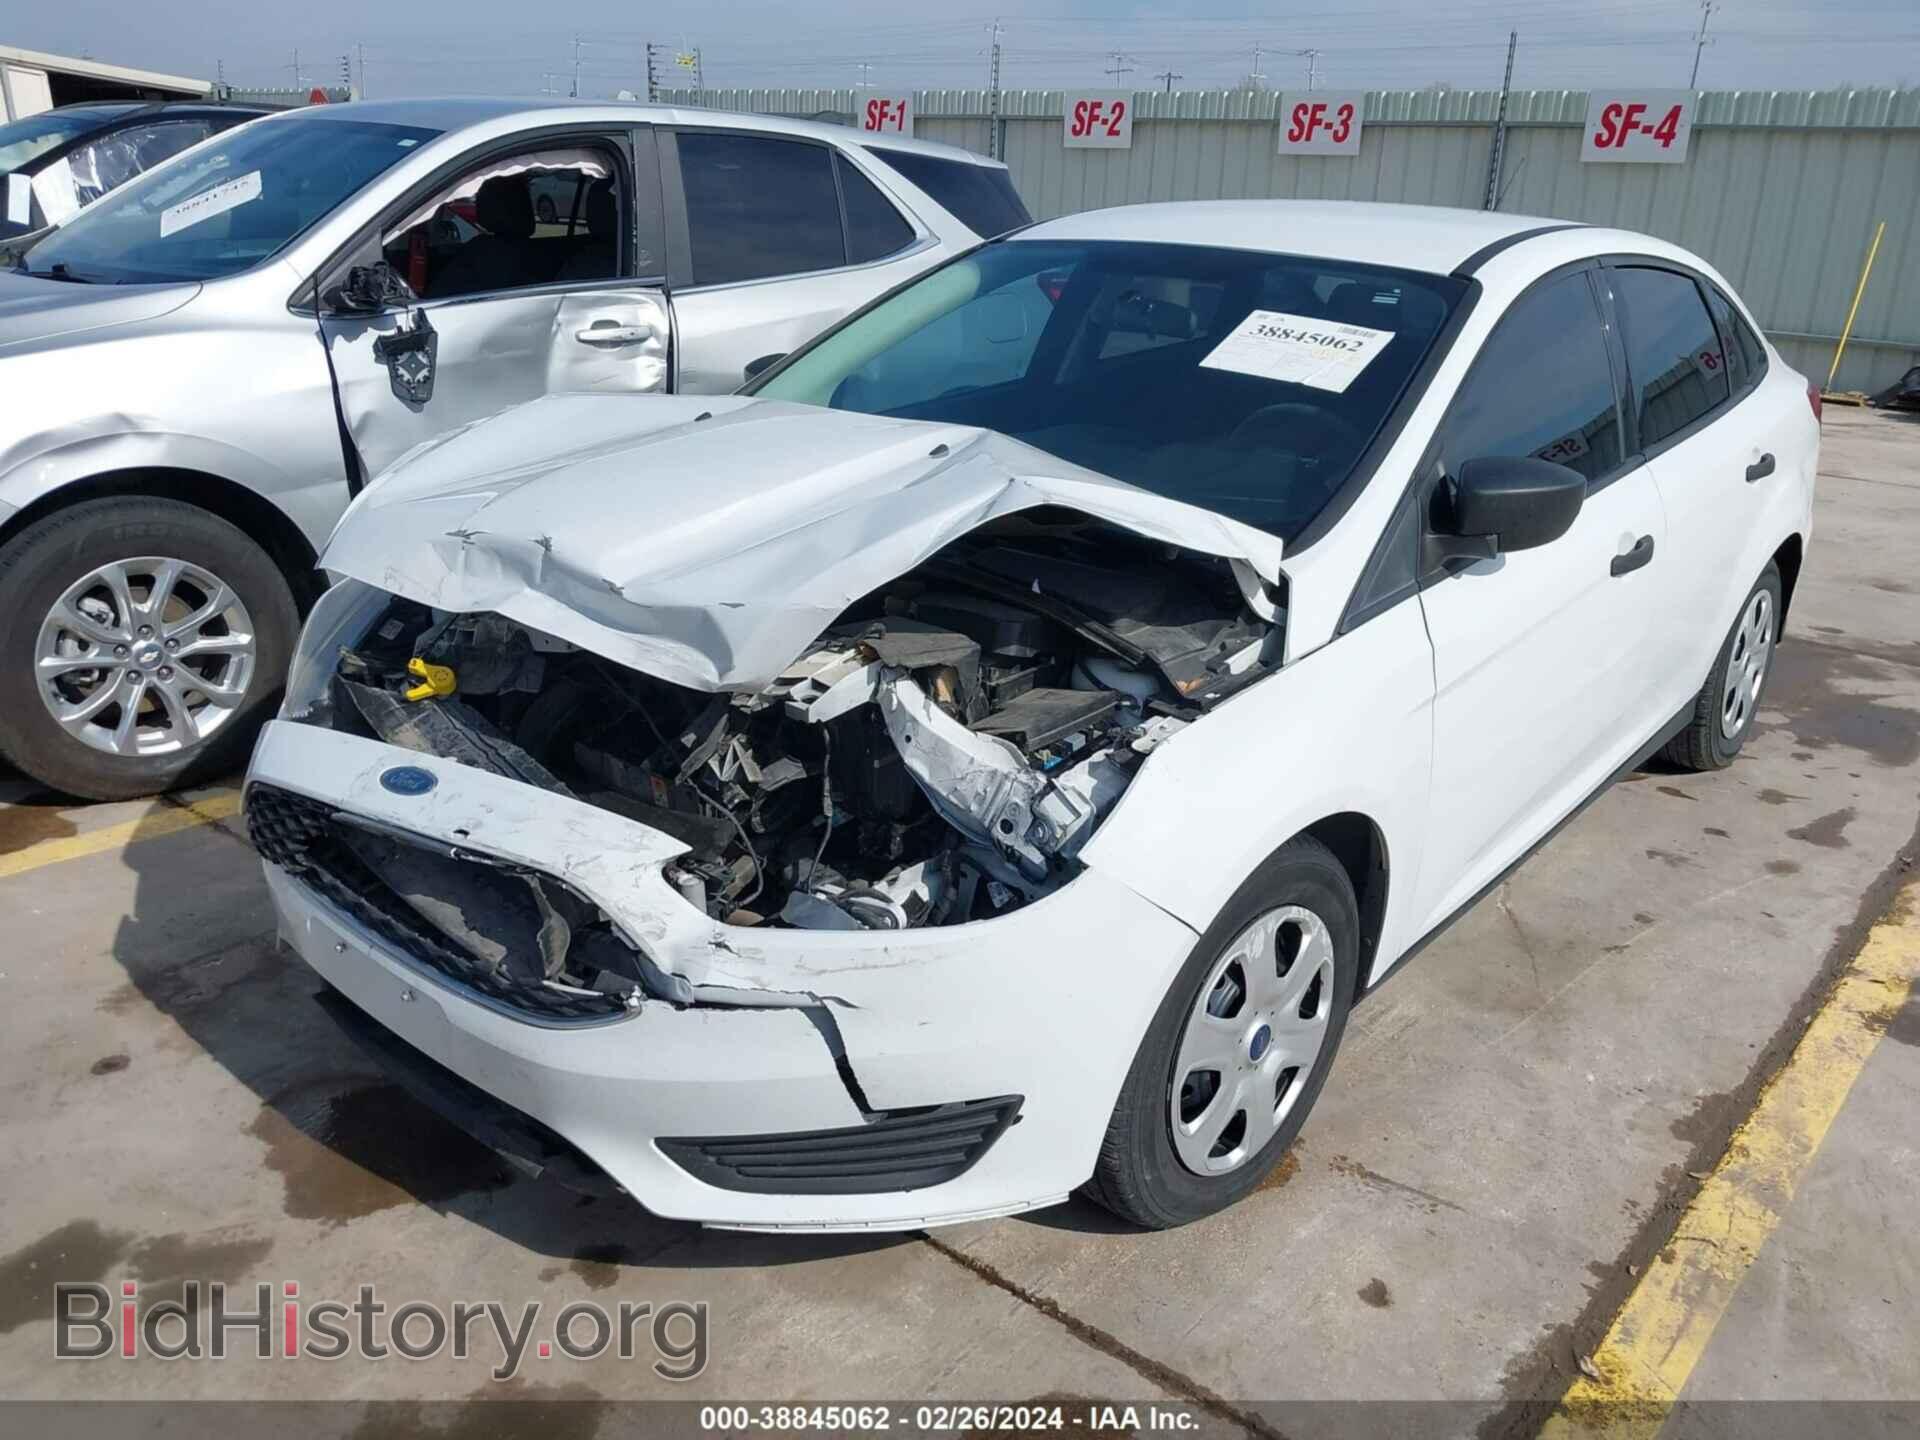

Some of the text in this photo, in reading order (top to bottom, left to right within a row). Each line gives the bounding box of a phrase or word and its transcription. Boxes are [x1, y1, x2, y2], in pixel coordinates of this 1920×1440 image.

[866, 100, 906, 131] SF-1
[1071, 101, 1125, 137] SF-2
[1287, 103, 1354, 143] SF-3
[1594, 104, 1682, 148] SF-4
[1249, 323, 1364, 352] 38845062
